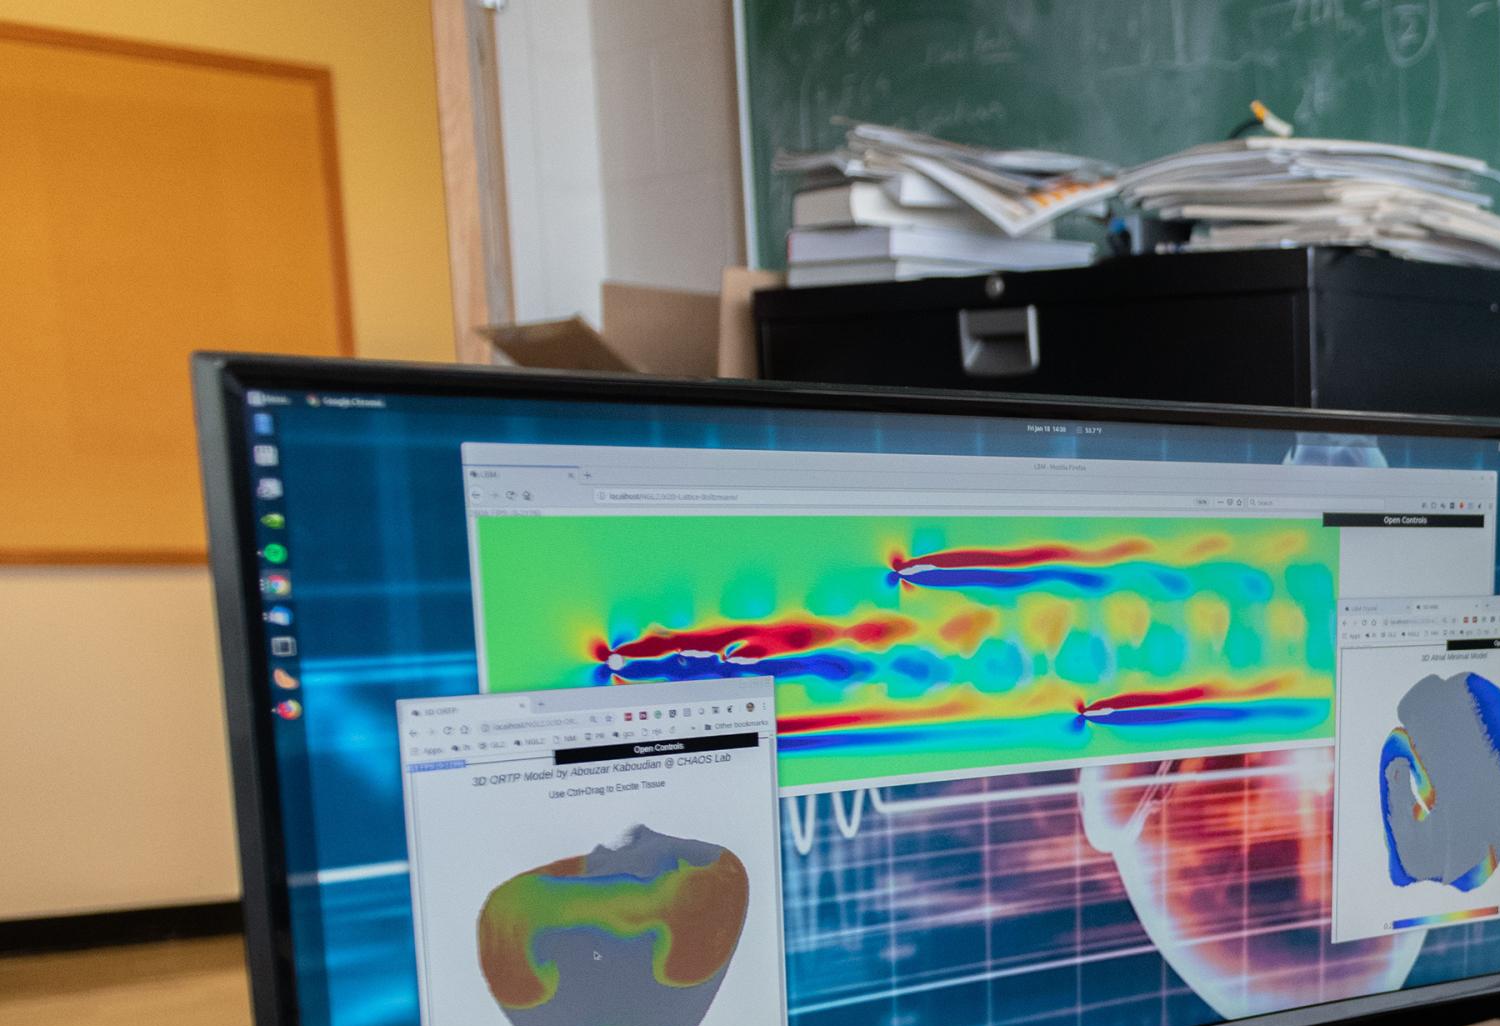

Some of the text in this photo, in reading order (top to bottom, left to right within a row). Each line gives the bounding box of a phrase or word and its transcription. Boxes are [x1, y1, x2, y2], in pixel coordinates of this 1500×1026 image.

[1384, 516, 1428, 525] Open Controls
[634, 741, 684, 754] Open Controls
[472, 776, 487, 787] 3D
[524, 769, 554, 782] Model
[556, 769, 568, 779] by
[571, 764, 609, 777] Abouzar
[612, 758, 661, 772] Kaboudian
[664, 757, 674, 769] @
[676, 754, 712, 767] CHAOS
[714, 752, 731, 763] Lab
[549, 789, 565, 799] Use
[606, 785, 614, 793] to
[616, 781, 639, 792] Excite
[642, 778, 666, 790] Tissue
